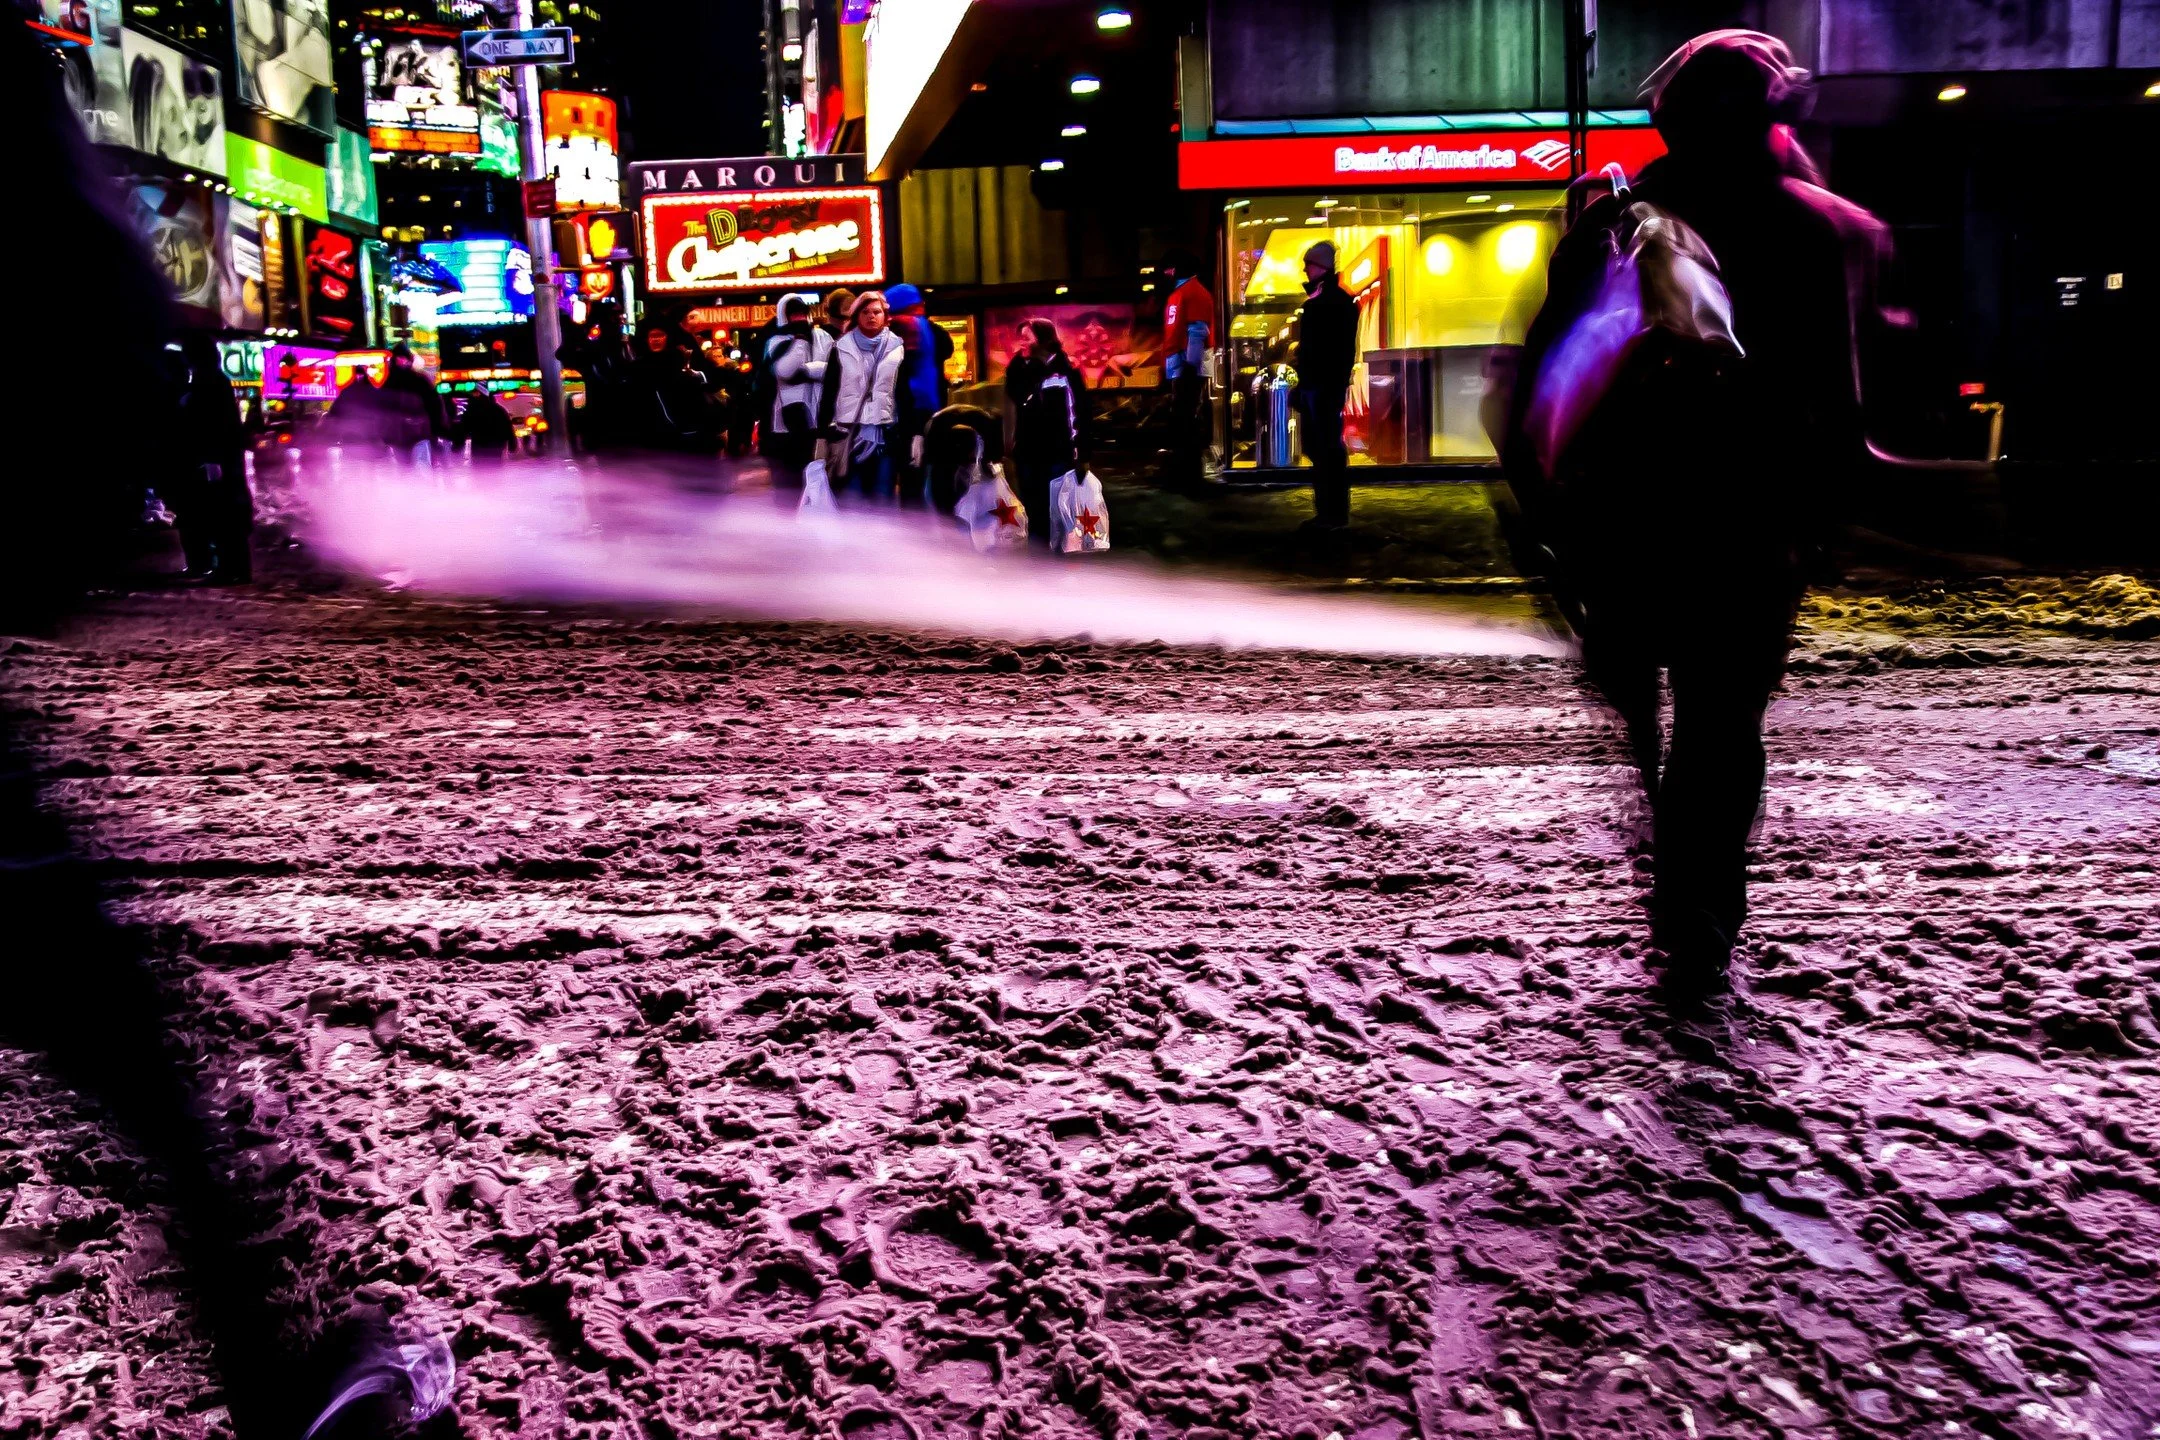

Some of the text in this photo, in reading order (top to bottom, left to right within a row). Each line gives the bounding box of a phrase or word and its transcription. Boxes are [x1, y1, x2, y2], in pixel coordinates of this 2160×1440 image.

[480, 39, 557, 56] ONE WAY
[1335, 144, 1516, 172] Bank of America
[683, 220, 707, 237] The
[667, 219, 860, 282] Chaperone
